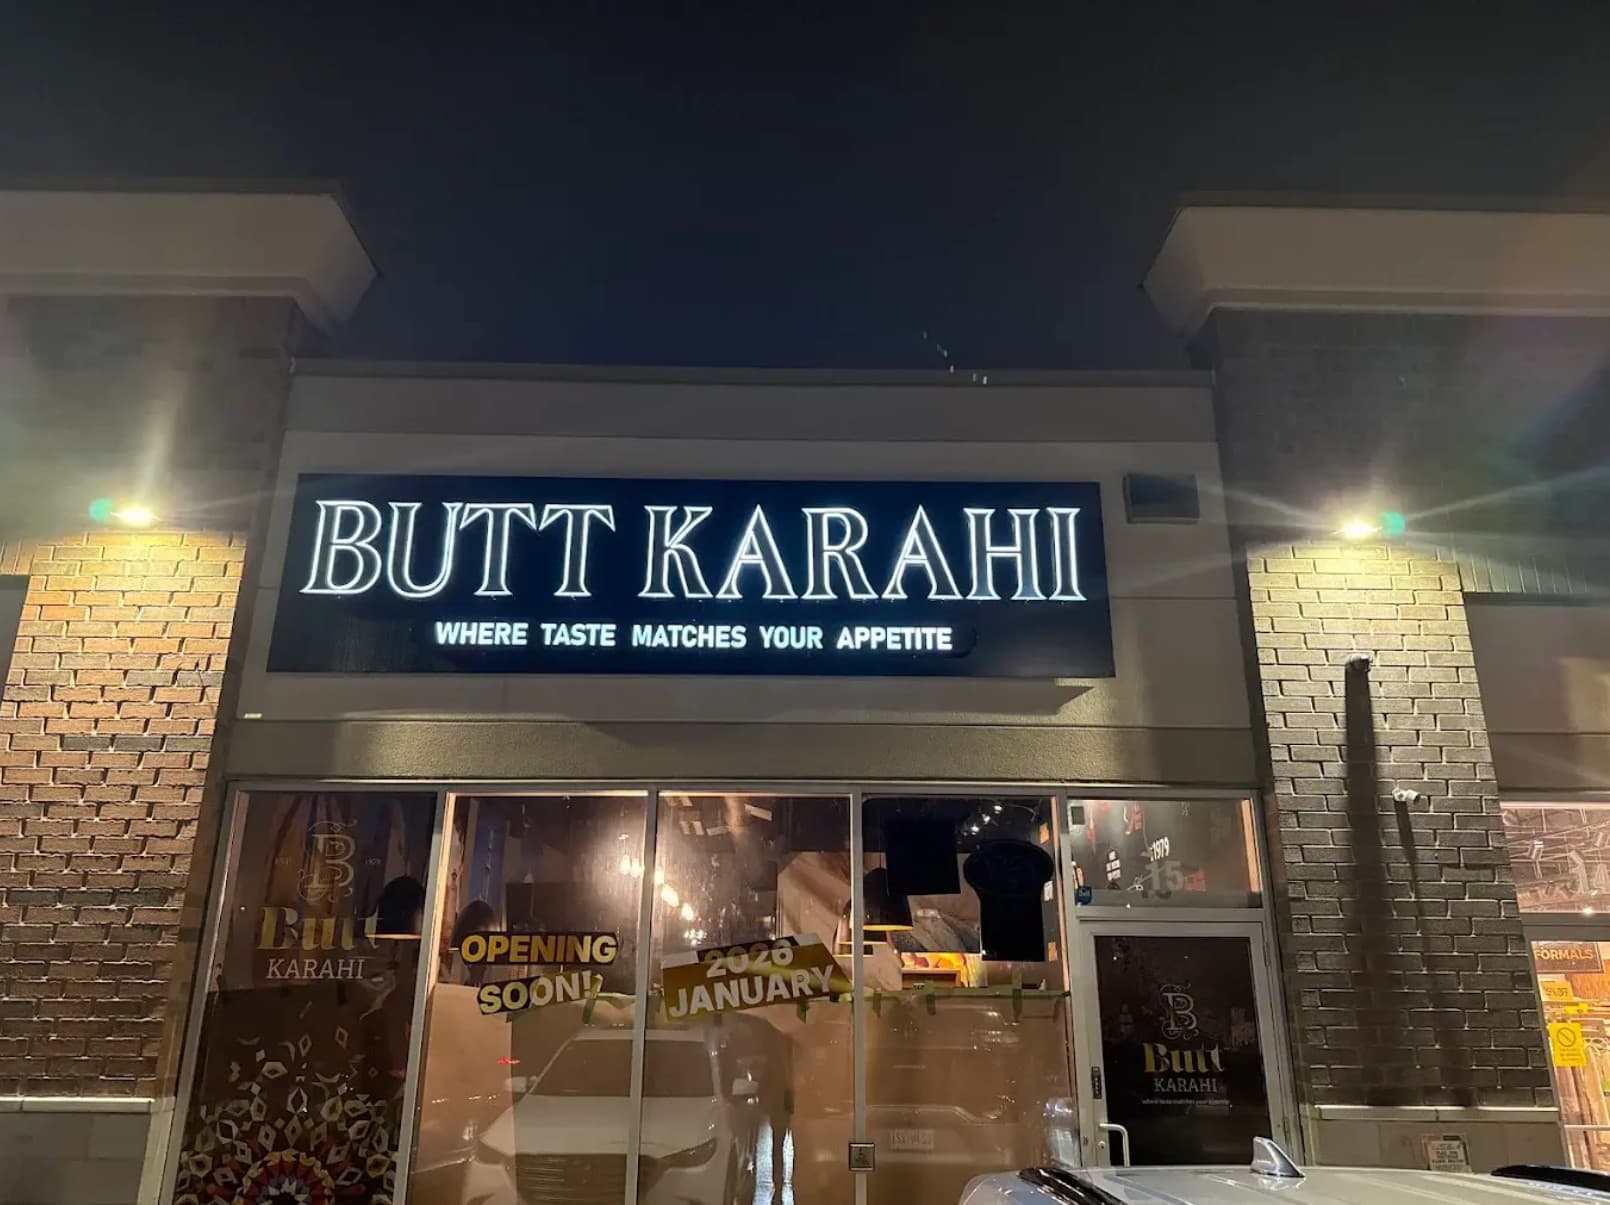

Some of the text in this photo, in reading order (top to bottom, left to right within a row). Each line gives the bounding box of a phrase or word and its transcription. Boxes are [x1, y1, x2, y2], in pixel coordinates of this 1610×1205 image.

[299, 500, 1088, 601] BUTT KARAHI
[435, 621, 953, 651] WHERE TASTE MATCHES YOUR APPETITE
[1145, 860, 1184, 890] 15
[460, 934, 618, 964] OPENING
[705, 938, 794, 978] 2026
[1535, 948, 1594, 961] FORMALS
[265, 957, 366, 980] KARAHI
[480, 970, 593, 1015] SOON!
[667, 964, 835, 1019] JANUARY
[1154, 1077, 1218, 1093] KARAHI
